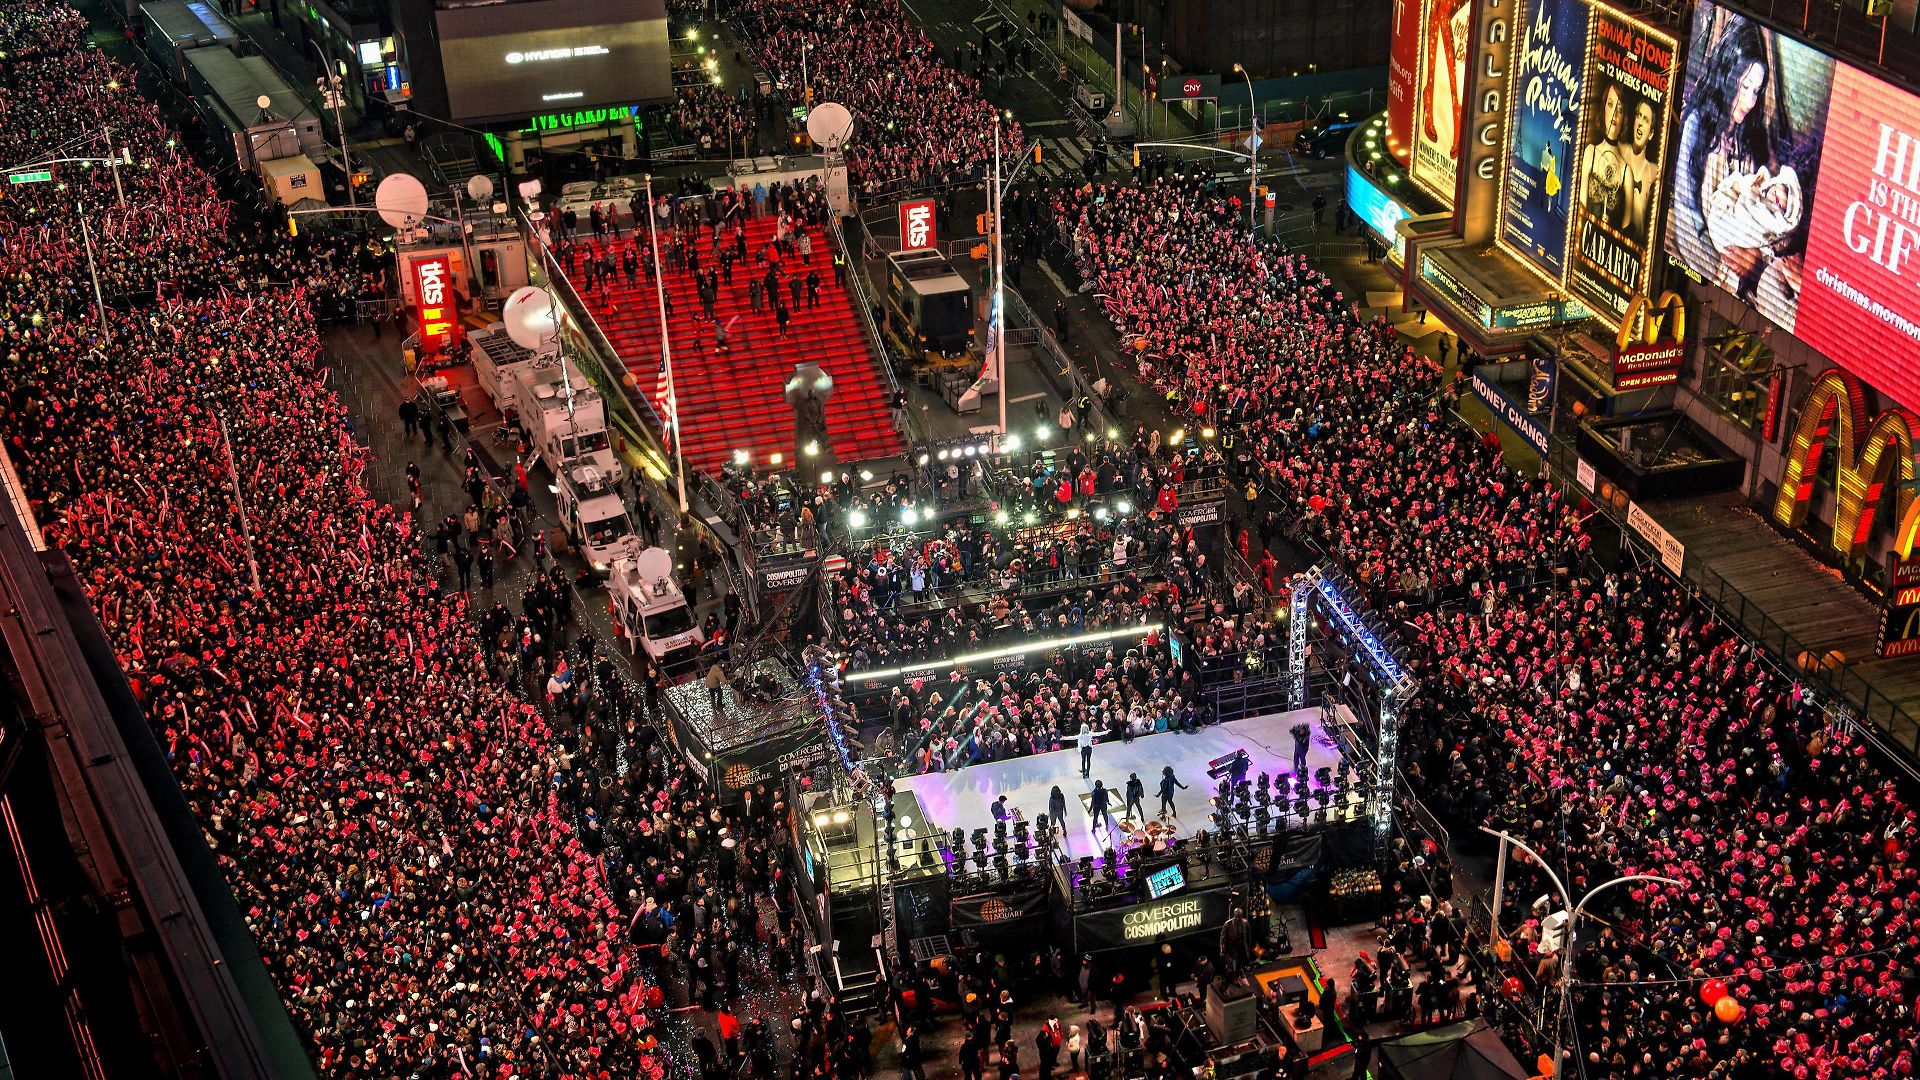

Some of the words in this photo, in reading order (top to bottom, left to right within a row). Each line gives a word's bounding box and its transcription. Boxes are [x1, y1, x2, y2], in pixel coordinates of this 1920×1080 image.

[1532, 0, 1551, 45] An
[1599, 18, 1631, 50] EMMA
[1634, 37, 1670, 70] STONE
[1520, 25, 1579, 112] American
[1596, 43, 1621, 67] ALAN
[1622, 57, 1668, 92] CUMMING
[1183, 83, 1201, 93] CNY
[1477, 0, 1506, 179] ALACE
[1606, 62, 1615, 78] 12
[1615, 67, 1641, 92] WEEKS
[1641, 83, 1663, 103] ONLY
[560, 106, 630, 127] GARDEN
[1525, 76, 1564, 129] Paris
[1868, 178, 1888, 208] IS
[909, 205, 931, 247] tkts
[1581, 220, 1639, 289] CABARET
[420, 261, 446, 305] tkts
[1618, 348, 1684, 364] McDonald's
[1627, 359, 1671, 370] Restaurant
[1620, 378, 1640, 387] OPEN
[1641, 376, 1651, 385] 24
[1472, 374, 1507, 414] MONEY
[1508, 407, 1548, 454] CHANGE
[1178, 507, 1218, 517] COVERGIRL
[766, 568, 808, 581] COSMOPOLITAN
[778, 742, 824, 763] COVERGIRL
[741, 772, 772, 786] SQUARE
[996, 910, 1024, 920] SQUARE
[1122, 900, 1201, 925] COVERGIRL
[1124, 912, 1201, 940] COSMOPOLITAN
